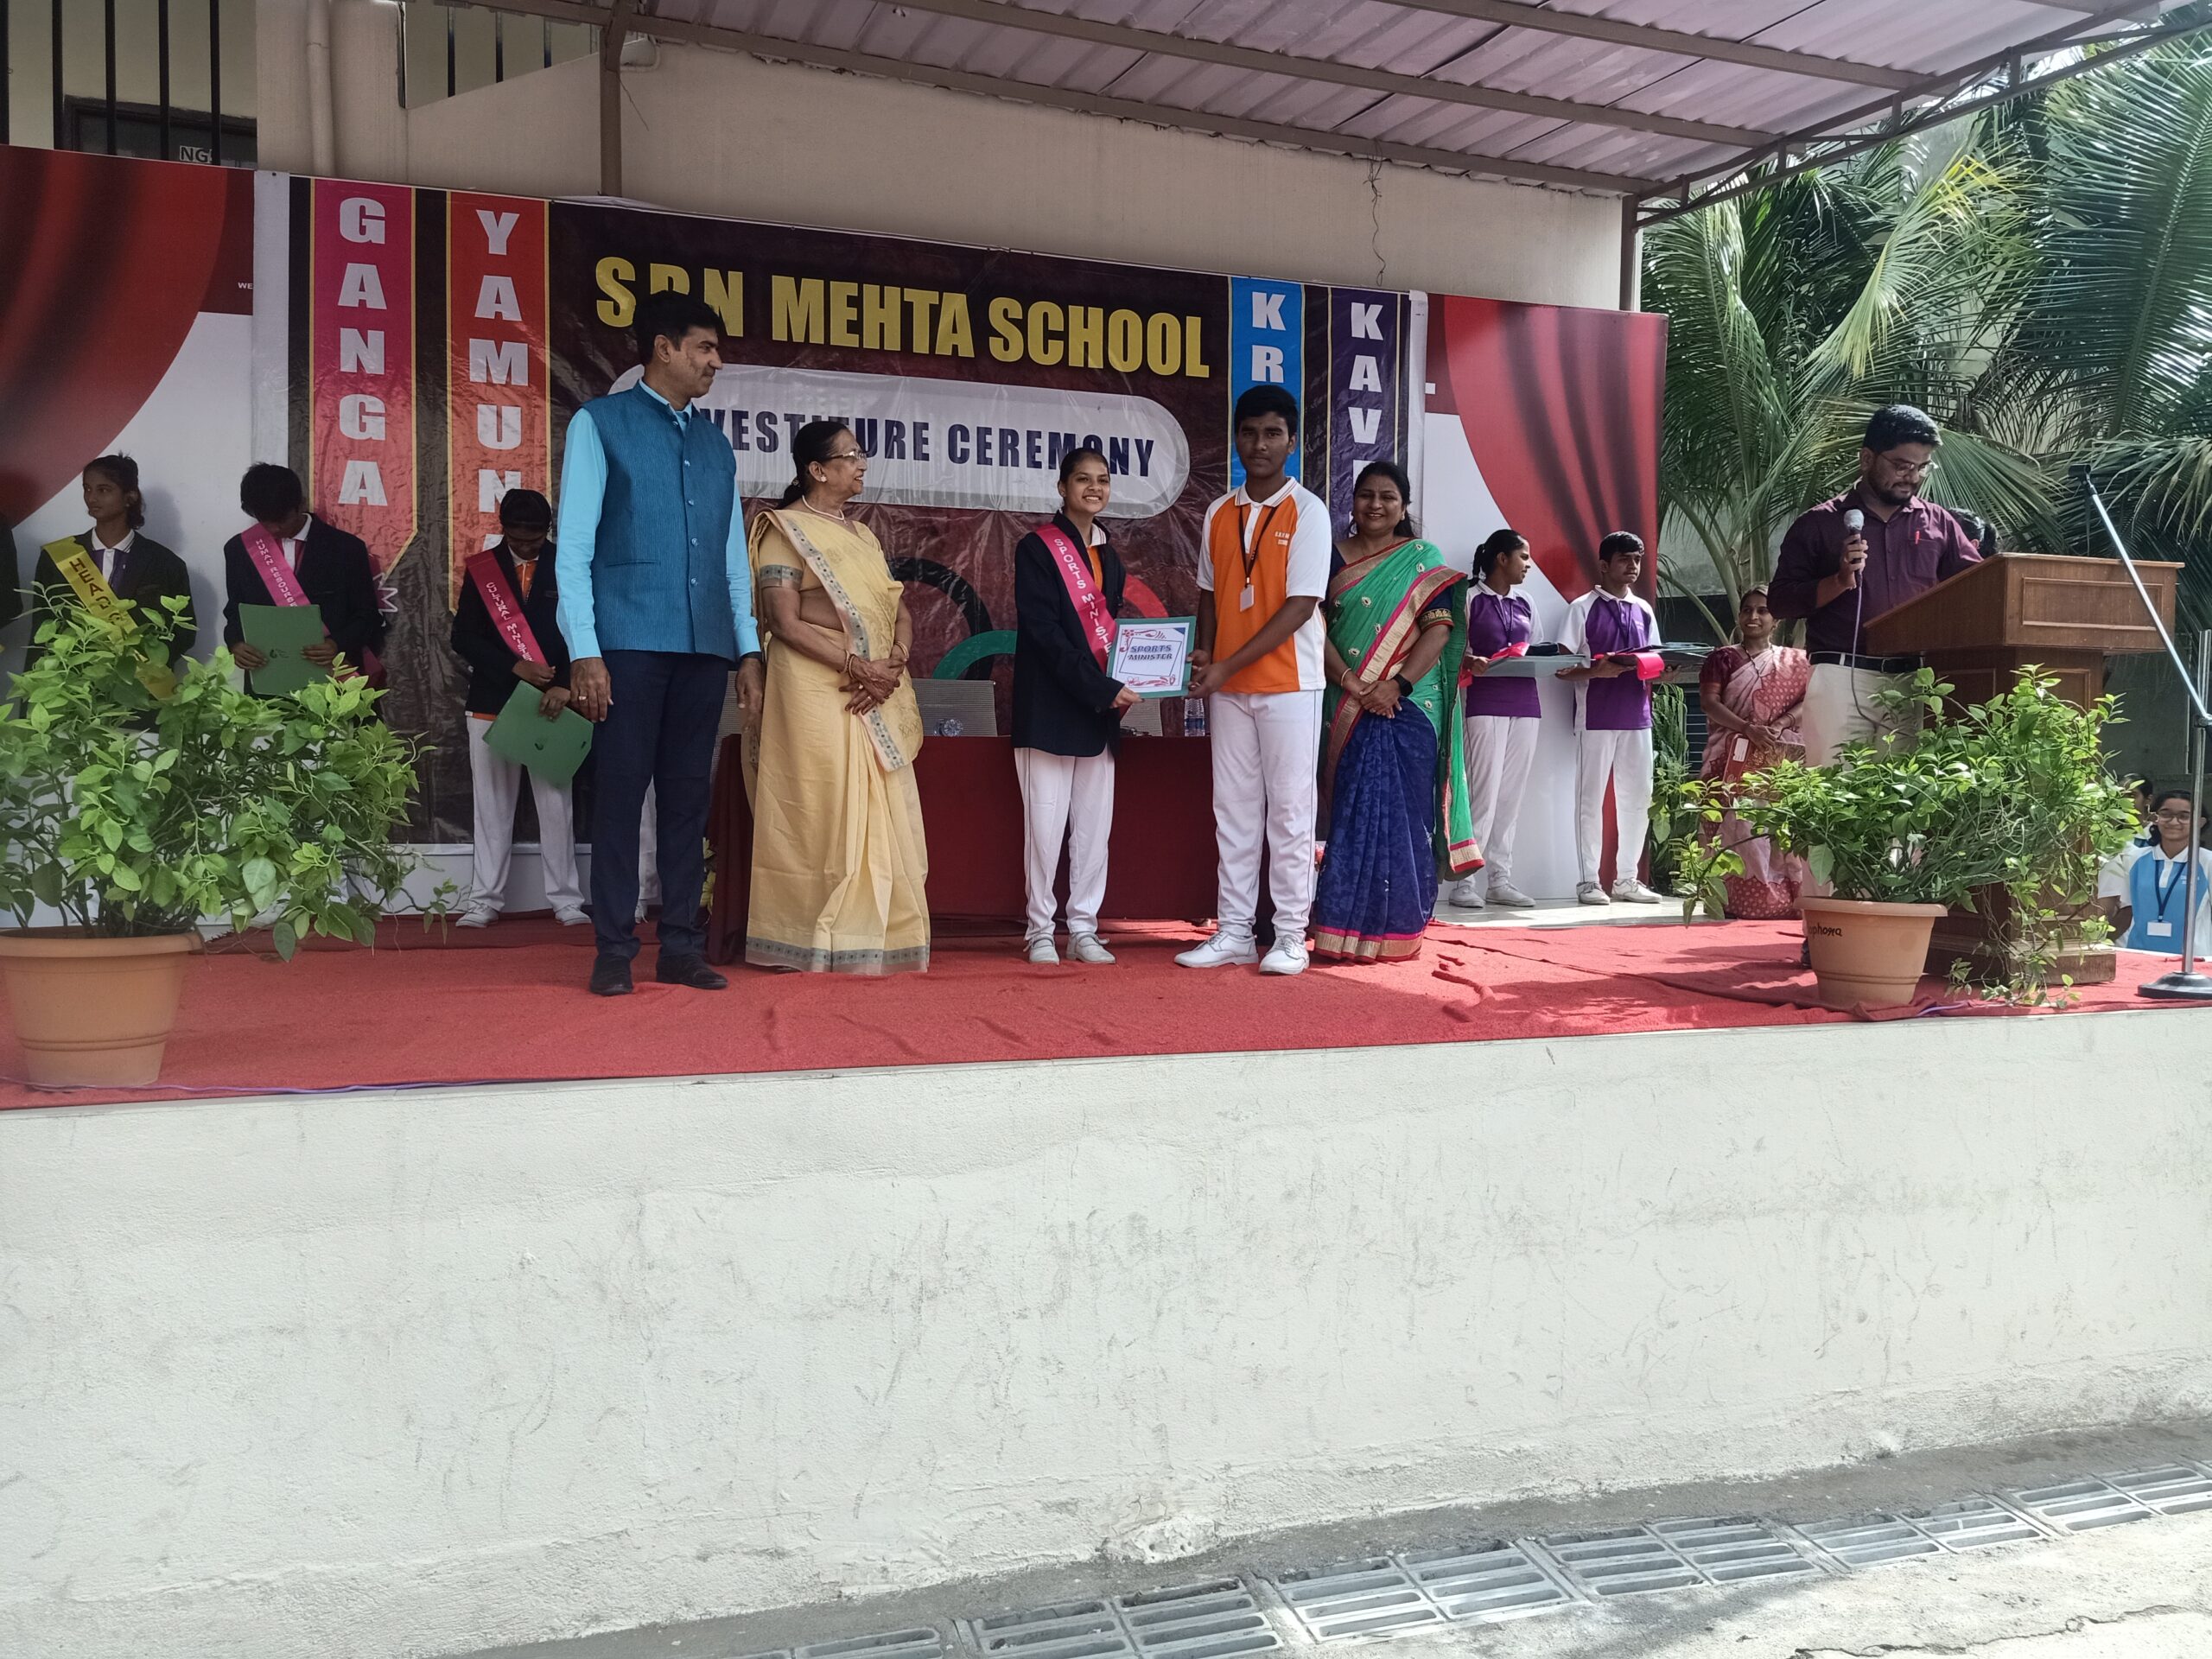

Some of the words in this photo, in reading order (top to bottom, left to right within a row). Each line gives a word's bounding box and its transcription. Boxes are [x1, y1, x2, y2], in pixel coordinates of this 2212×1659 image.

[337, 197, 387, 506] GANGA
[771, 274, 976, 359] MEHTA
[988, 296, 1210, 378] SCHOOL
[468, 209, 529, 552] YAMUN
[486, 582, 512, 621] CULTURAL
[1053, 538, 1087, 589] SPORTS
[1081, 593, 1113, 657] MINISTE
[1129, 645, 1173, 653] SPORTS
[1128, 652, 1173, 661] MINISTER
